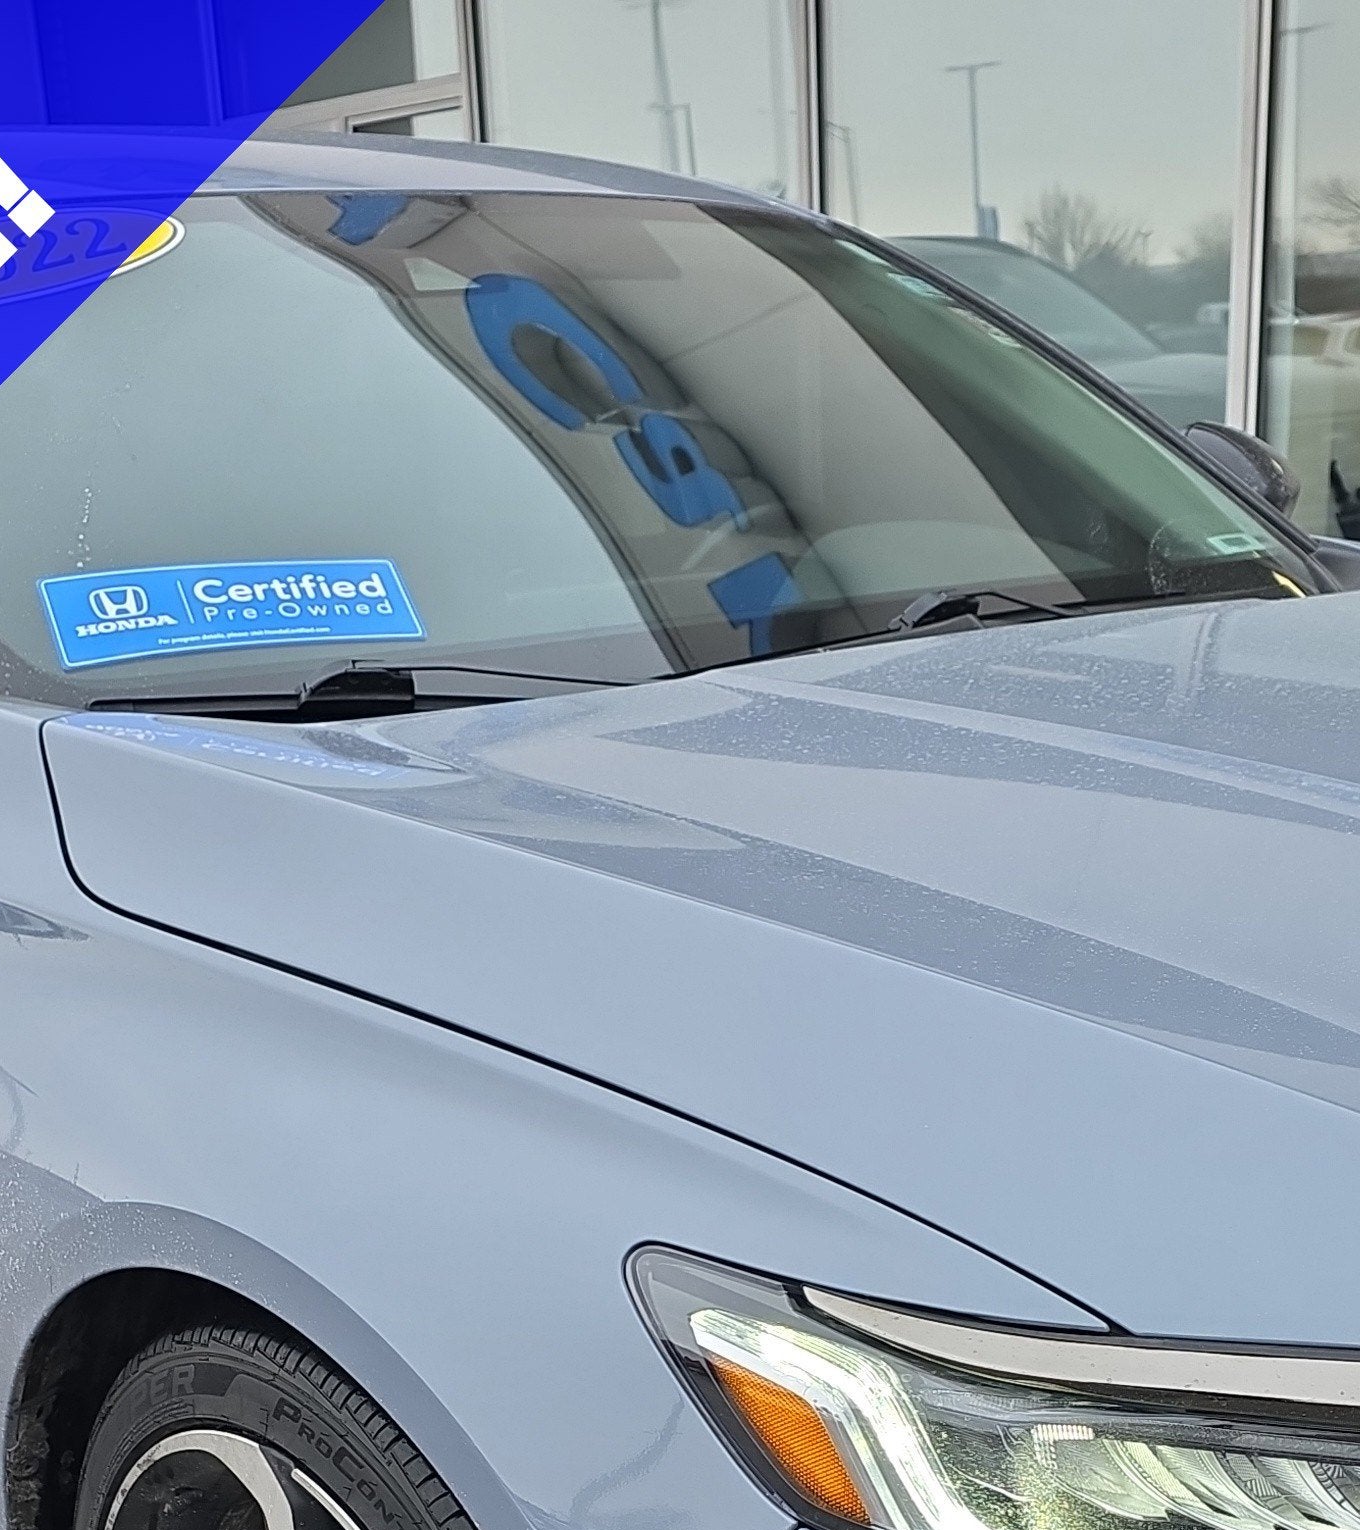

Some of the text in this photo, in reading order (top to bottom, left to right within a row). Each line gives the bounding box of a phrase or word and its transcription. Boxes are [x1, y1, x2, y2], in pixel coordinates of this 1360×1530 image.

[193, 573, 387, 604] Certified
[203, 599, 395, 622] Pre-Owned
[76, 614, 178, 638] HONDA
